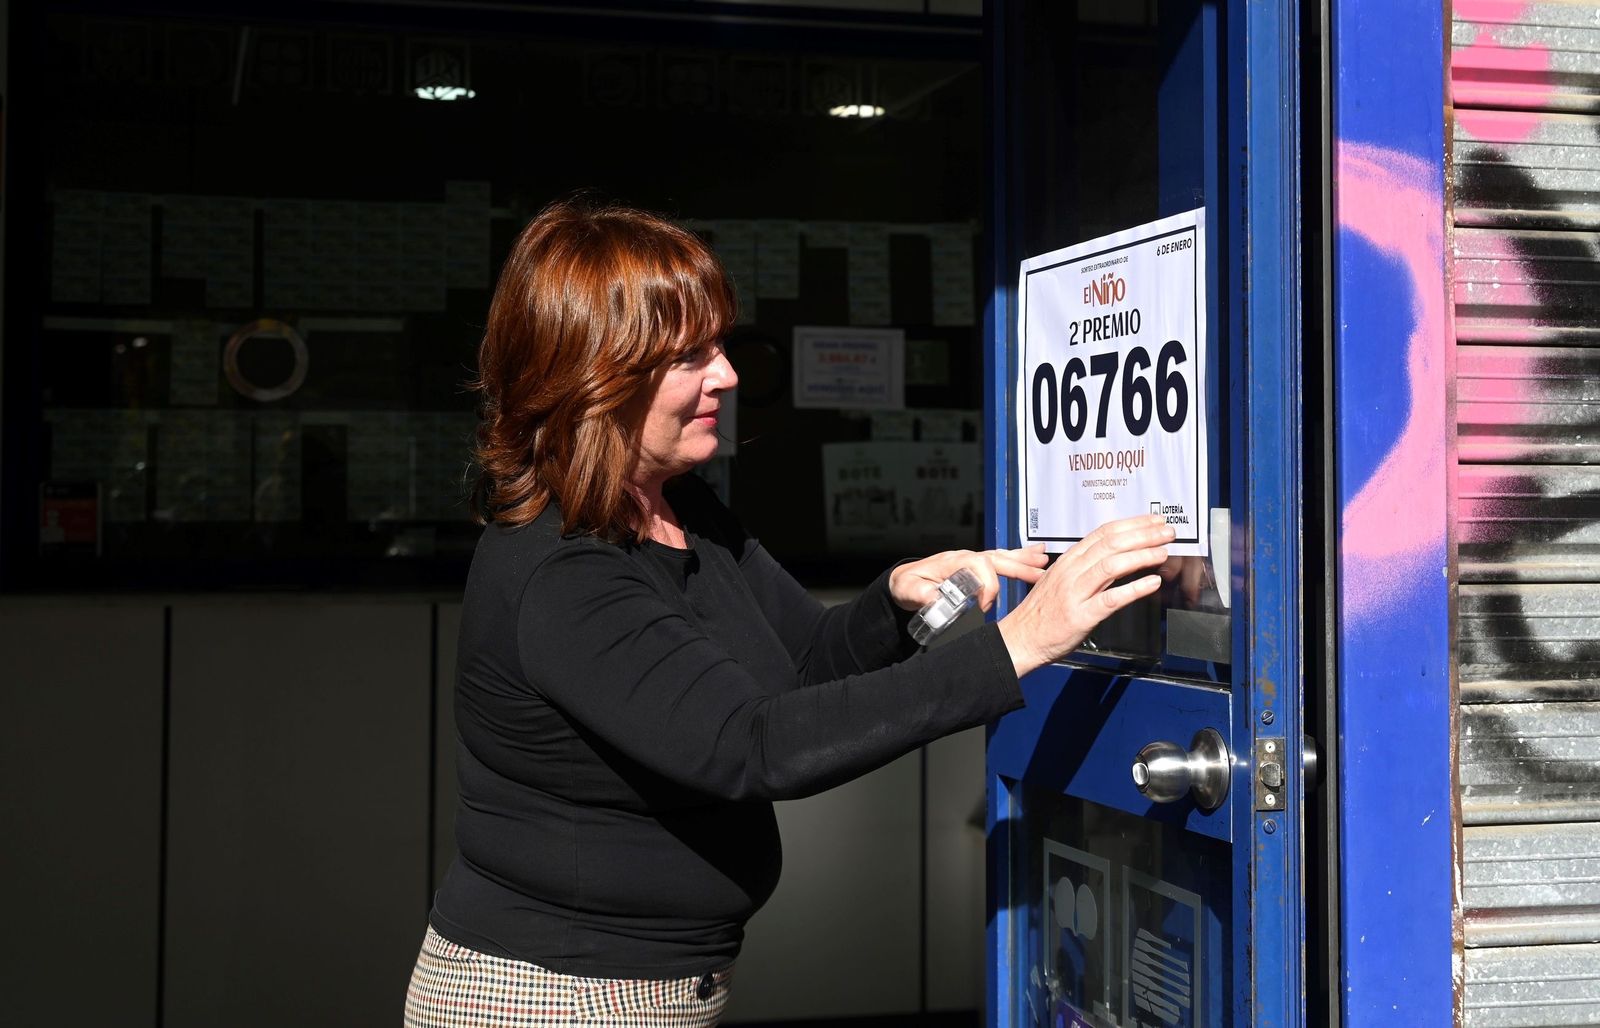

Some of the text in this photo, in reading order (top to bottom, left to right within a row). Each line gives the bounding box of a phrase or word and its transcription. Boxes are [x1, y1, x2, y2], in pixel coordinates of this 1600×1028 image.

[1156, 238, 1192, 256] 6 DE ENERO
[1081, 265, 1094, 274] SORTEO
[1092, 272, 1126, 307] Niño
[1083, 308, 1141, 343] PREMIO
[1032, 340, 1189, 444] 06766
[1069, 452, 1114, 471] VENDIDO
[1162, 504, 1184, 514] LOTERÍA
[1164, 515, 1189, 524] ACIONAL
